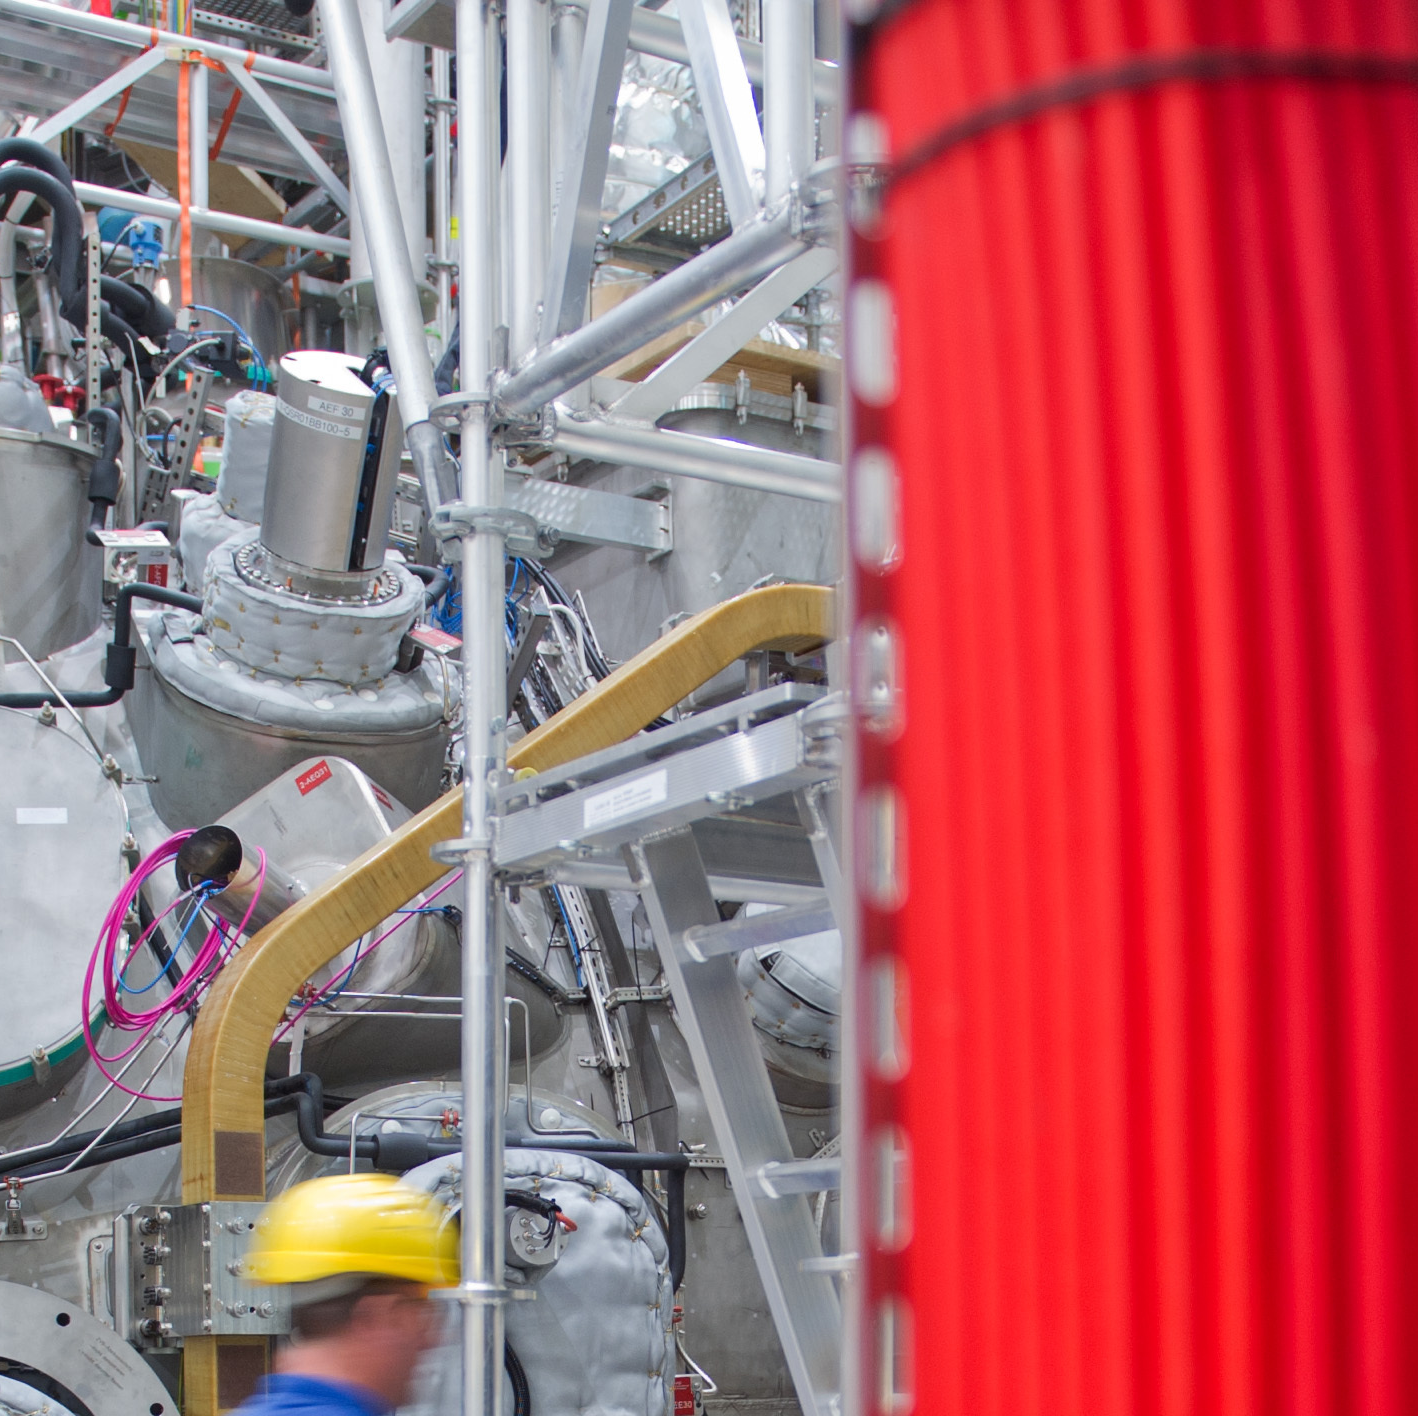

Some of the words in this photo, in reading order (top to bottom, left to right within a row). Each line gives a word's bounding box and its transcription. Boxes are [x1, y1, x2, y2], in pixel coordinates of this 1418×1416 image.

[319, 401, 340, 413] AEF
[341, 406, 354, 418] 30
[299, 766, 329, 789] 2-AEQ31
